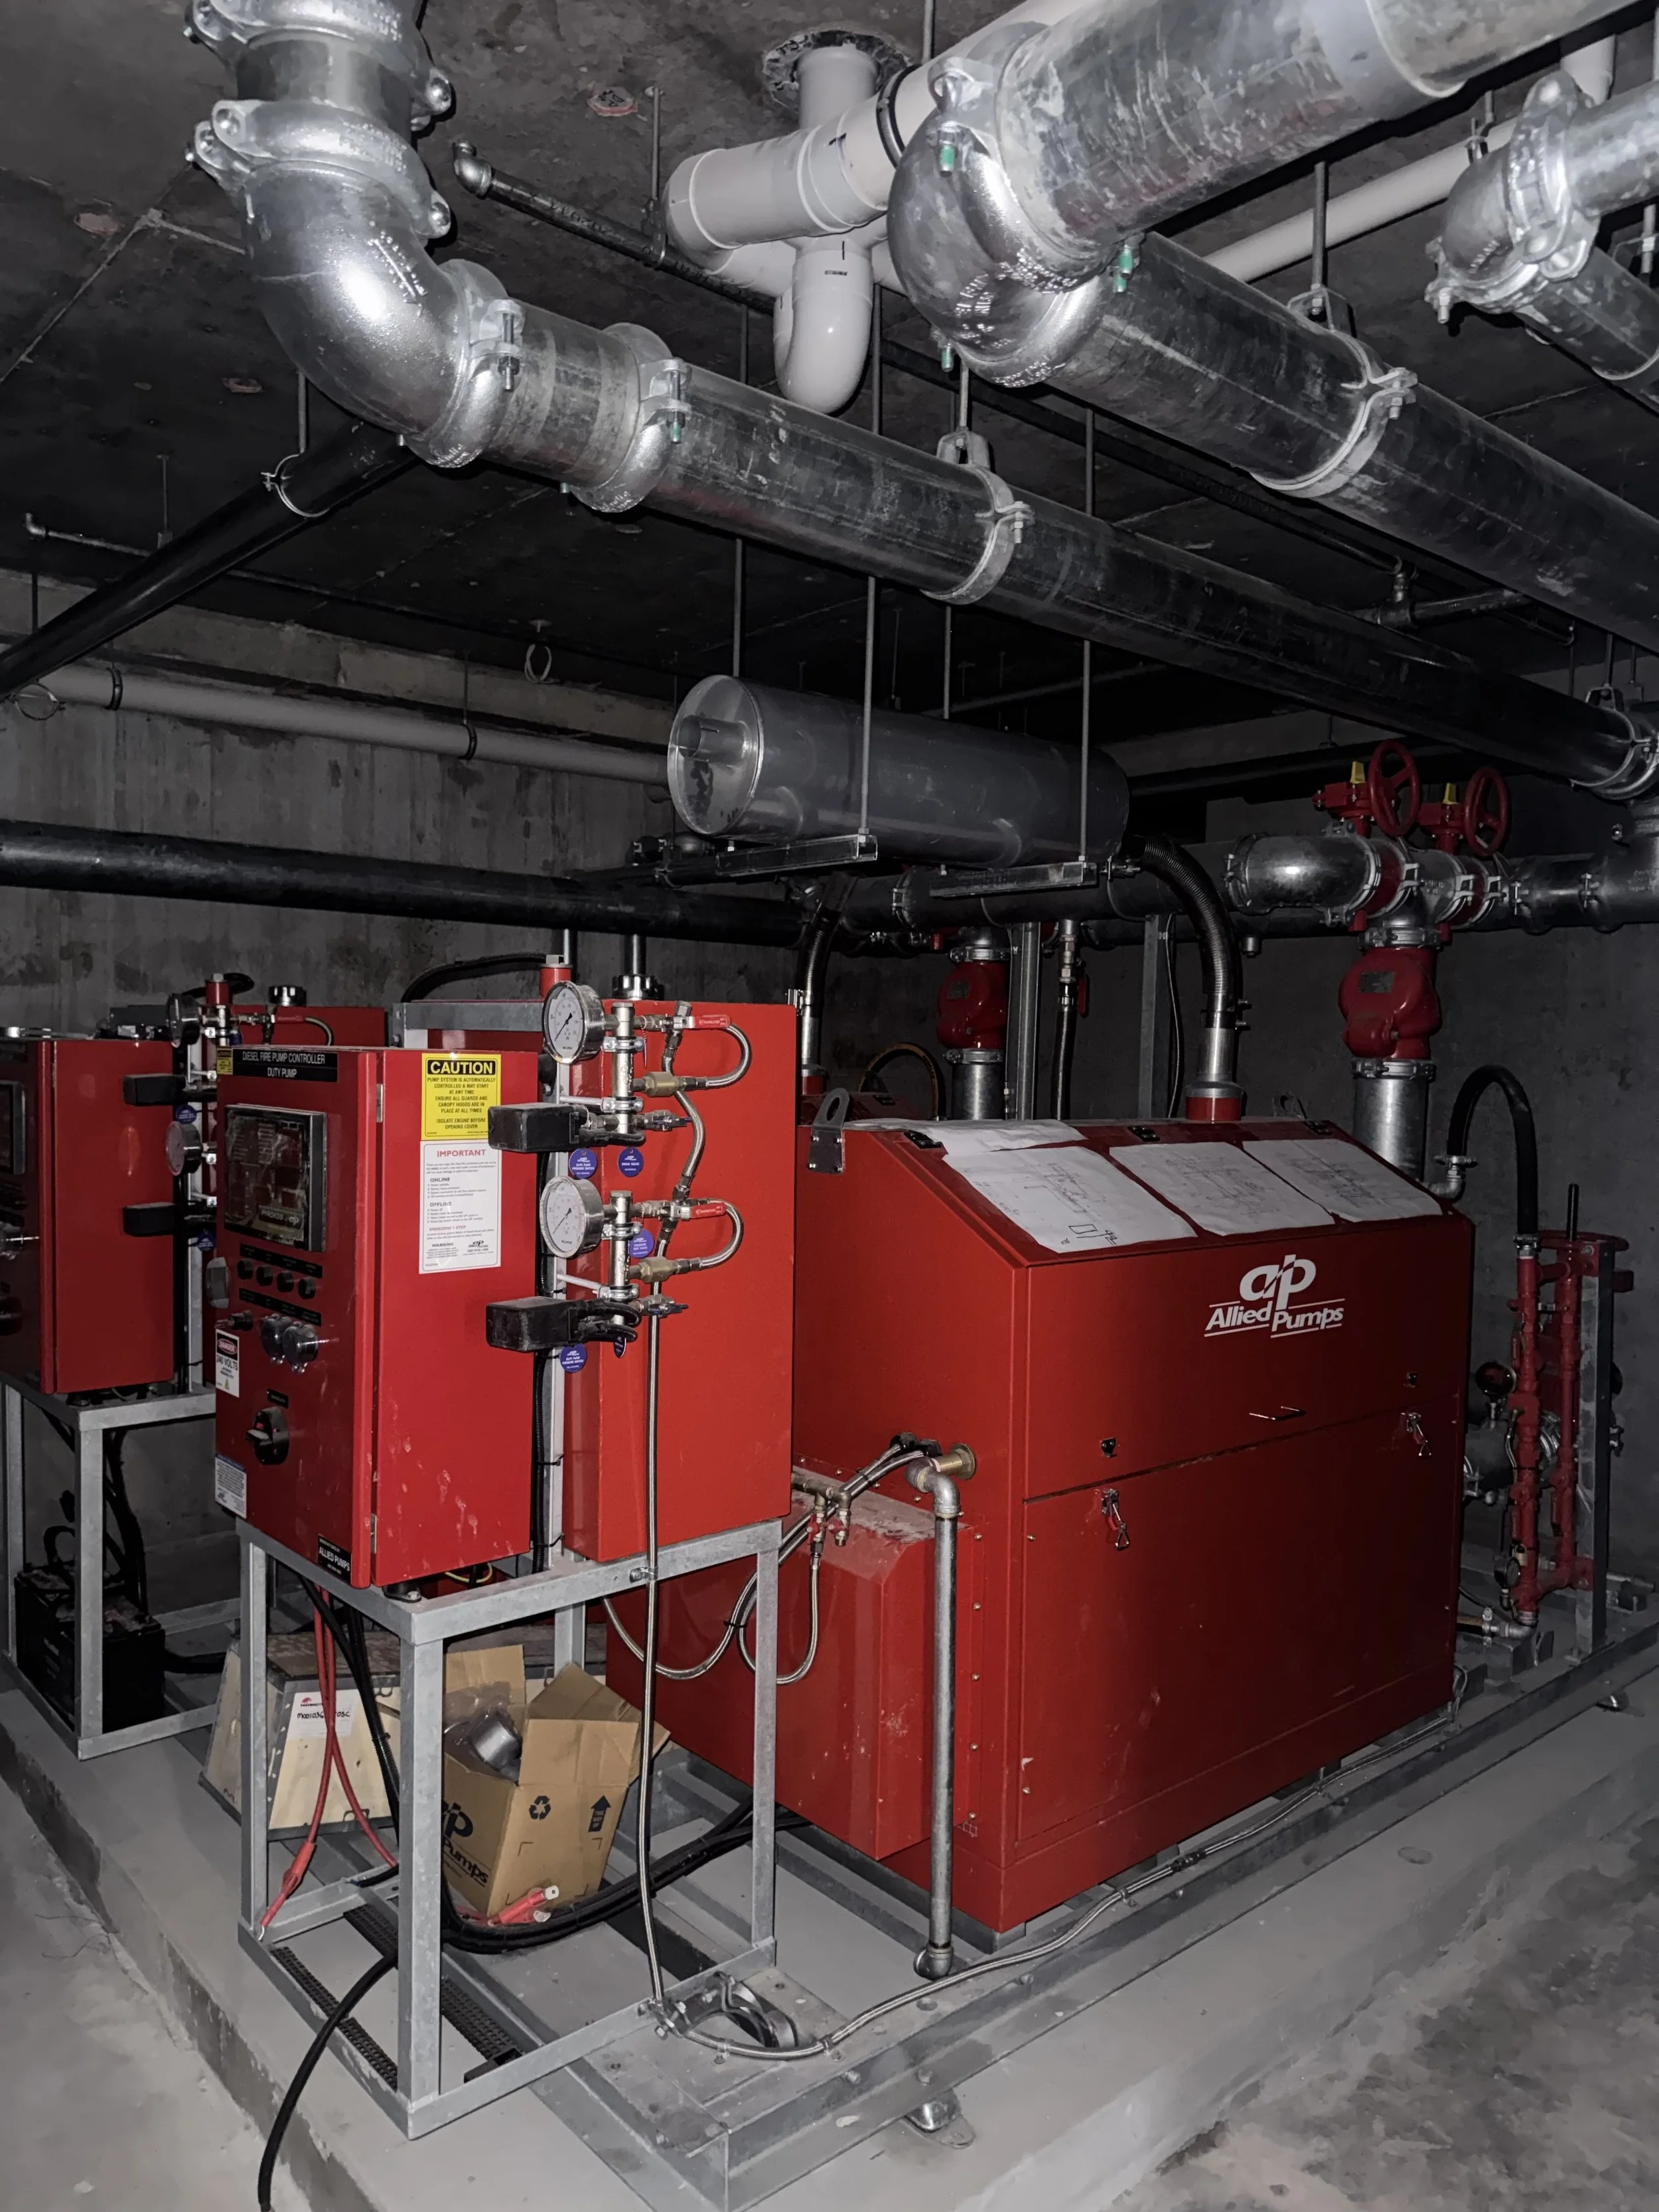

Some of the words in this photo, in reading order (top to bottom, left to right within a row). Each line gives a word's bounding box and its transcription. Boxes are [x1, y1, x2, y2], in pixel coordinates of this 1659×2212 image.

[242, 1051, 259, 1061] DIESEL
[260, 1052, 271, 1062] FIRE
[272, 1053, 287, 1063] PUMP
[289, 1053, 325, 1065] CONTROLLER
[267, 1067, 281, 1077] DUTY
[281, 1068, 297, 1078] PUMP
[430, 1061, 492, 1074] CAUTION
[437, 1149, 486, 1157] IMPORTANT
[1239, 1254, 1317, 1311] ap
[1205, 1300, 1273, 1331] Allied
[1271, 1307, 1344, 1333] Pumps
[224, 1358, 238, 1371] VOLTS
[319, 1546, 334, 1562] ALLIED
[334, 1554, 350, 1572] PUMPS
[443, 1836, 489, 1884] Pumps
